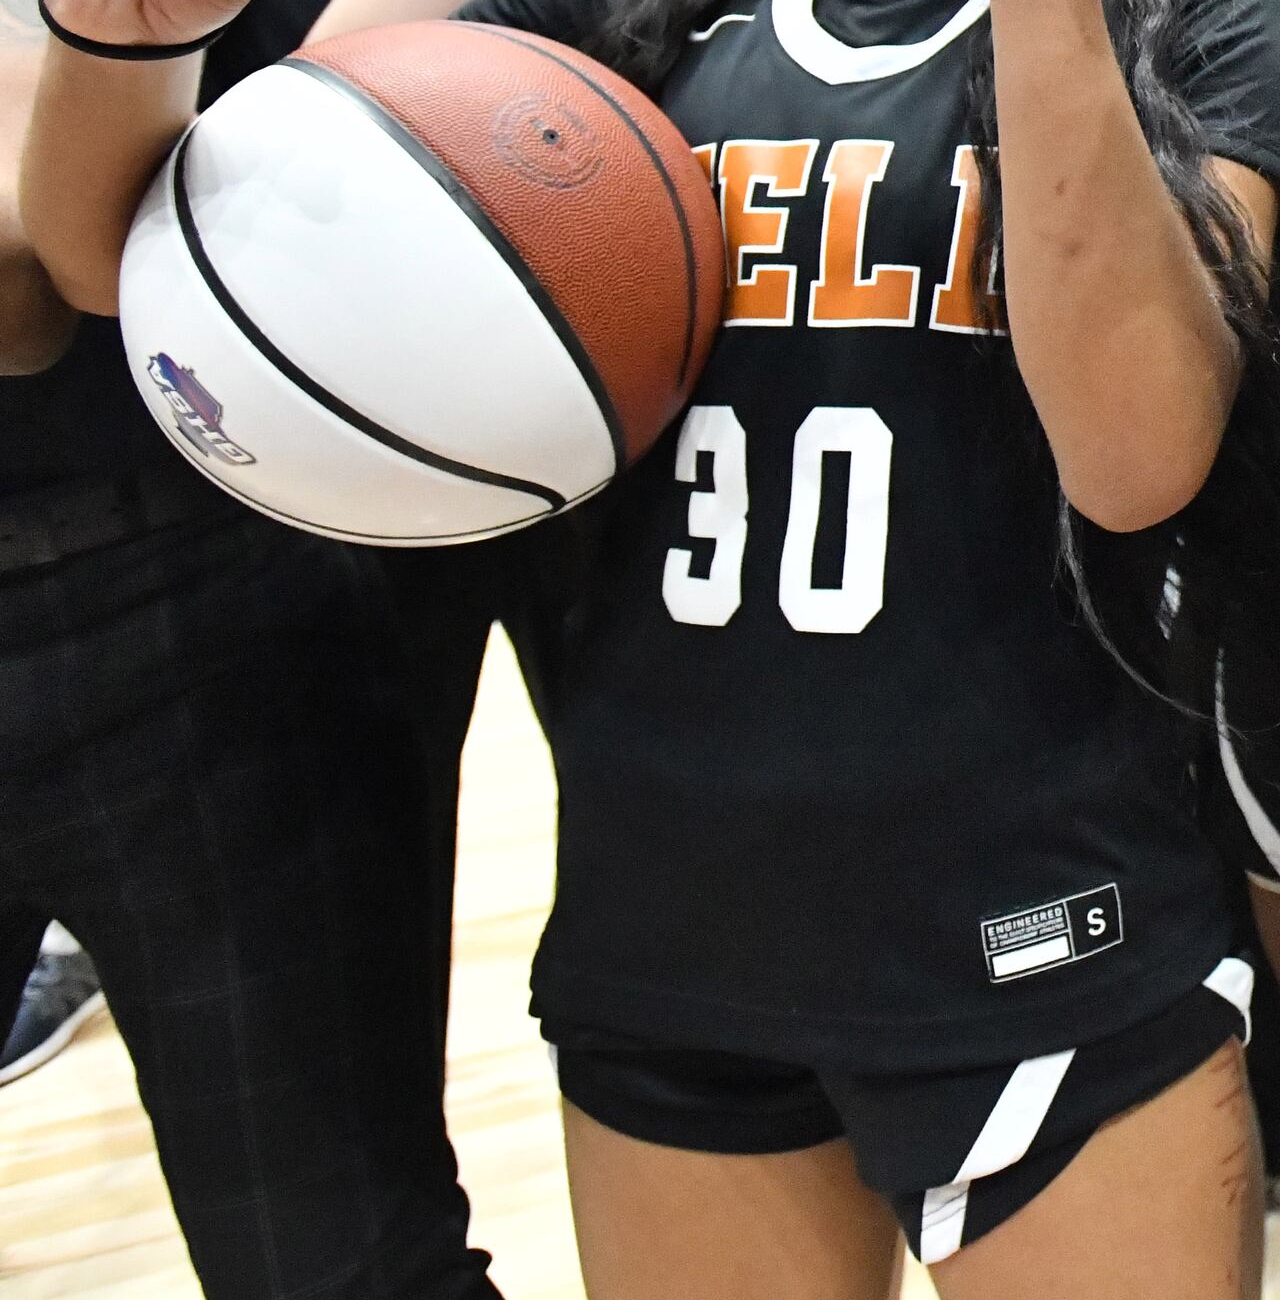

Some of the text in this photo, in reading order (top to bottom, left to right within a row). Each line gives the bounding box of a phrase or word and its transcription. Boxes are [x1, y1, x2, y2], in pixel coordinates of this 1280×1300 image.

[661, 405, 893, 634] 30
[987, 906, 1064, 938] ENGINEERED
[1087, 907, 1107, 936] S
